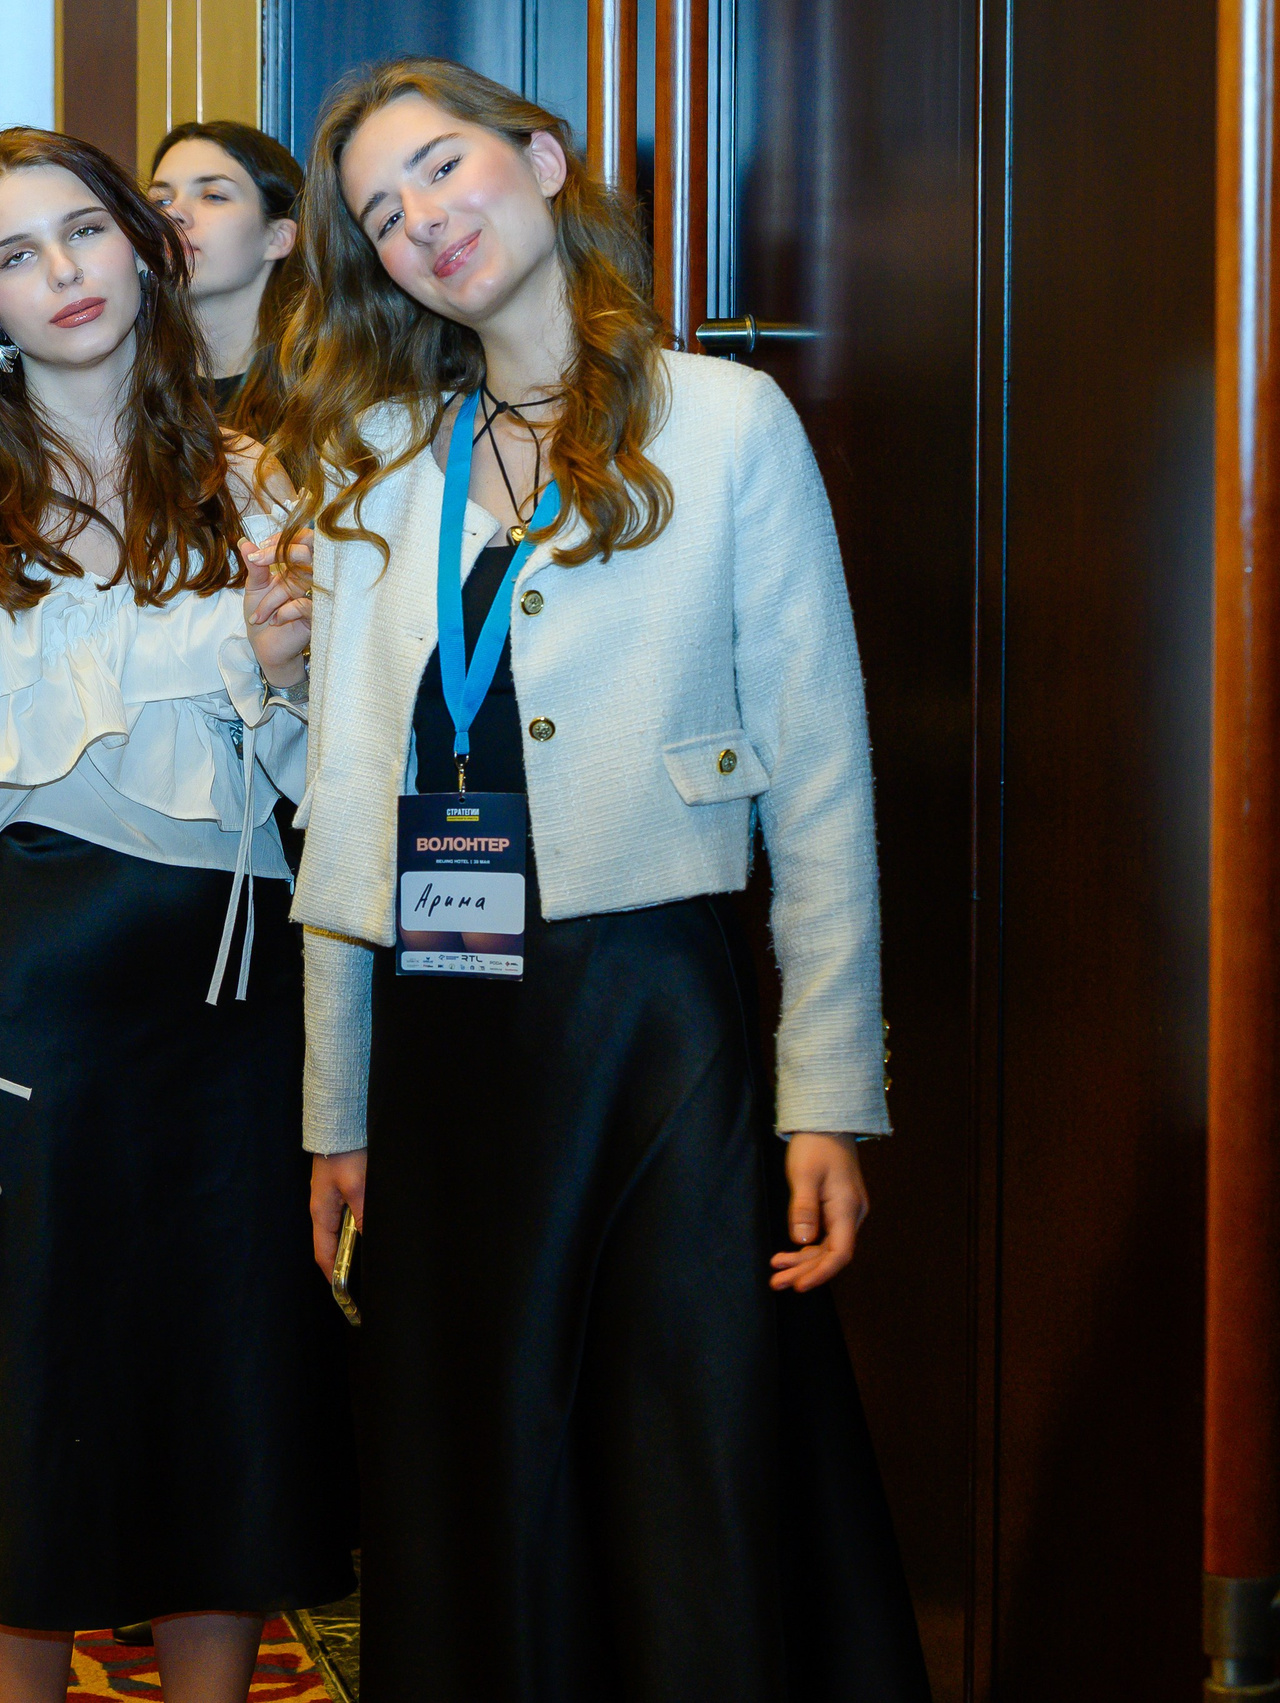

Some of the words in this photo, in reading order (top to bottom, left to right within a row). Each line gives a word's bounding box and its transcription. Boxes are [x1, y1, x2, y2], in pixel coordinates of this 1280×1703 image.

[446, 808, 480, 816] СТРАТЕГИИ
[416, 837, 510, 852] ВОЛОНТЕР
[414, 882, 486, 918] Арина
[461, 954, 483, 963] RTL
